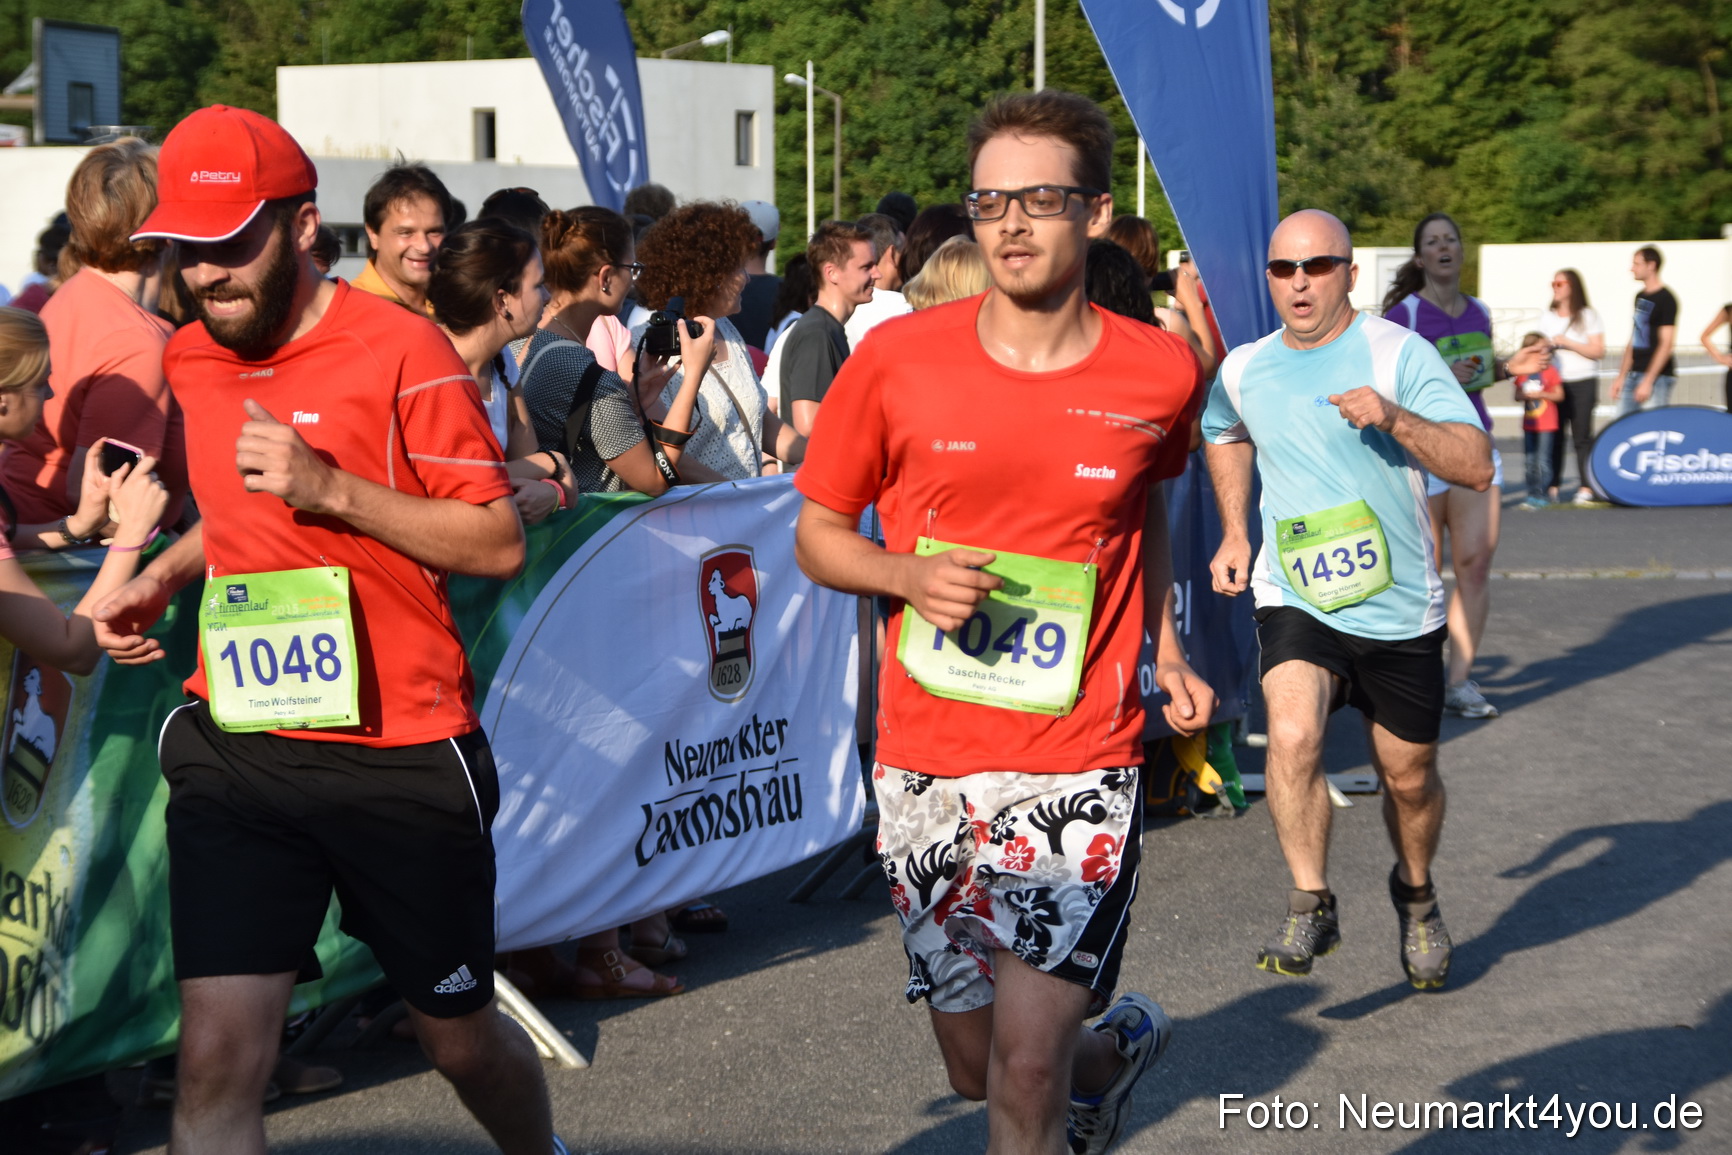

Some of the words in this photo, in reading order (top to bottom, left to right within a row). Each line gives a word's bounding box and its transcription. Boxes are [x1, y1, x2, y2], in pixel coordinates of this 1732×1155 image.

[199, 170, 241, 183] Petry
[292, 410, 319, 424] Timo
[946, 441, 976, 451] JAKO
[655, 451, 675, 480] SONY
[1074, 463, 1116, 480] Sascha
[1292, 538, 1378, 588] 1435
[1318, 588, 1339, 599] Georg
[219, 599, 269, 614] firmenlauf
[271, 603, 299, 616] 2015
[219, 632, 342, 688] 1048
[716, 663, 742, 687] 1628
[947, 665, 987, 681] Sascha
[989, 672, 1027, 687] Recker
[248, 699, 270, 708] Timo
[271, 695, 322, 707] Wolfsteiner
[433, 979, 477, 994] adidas
